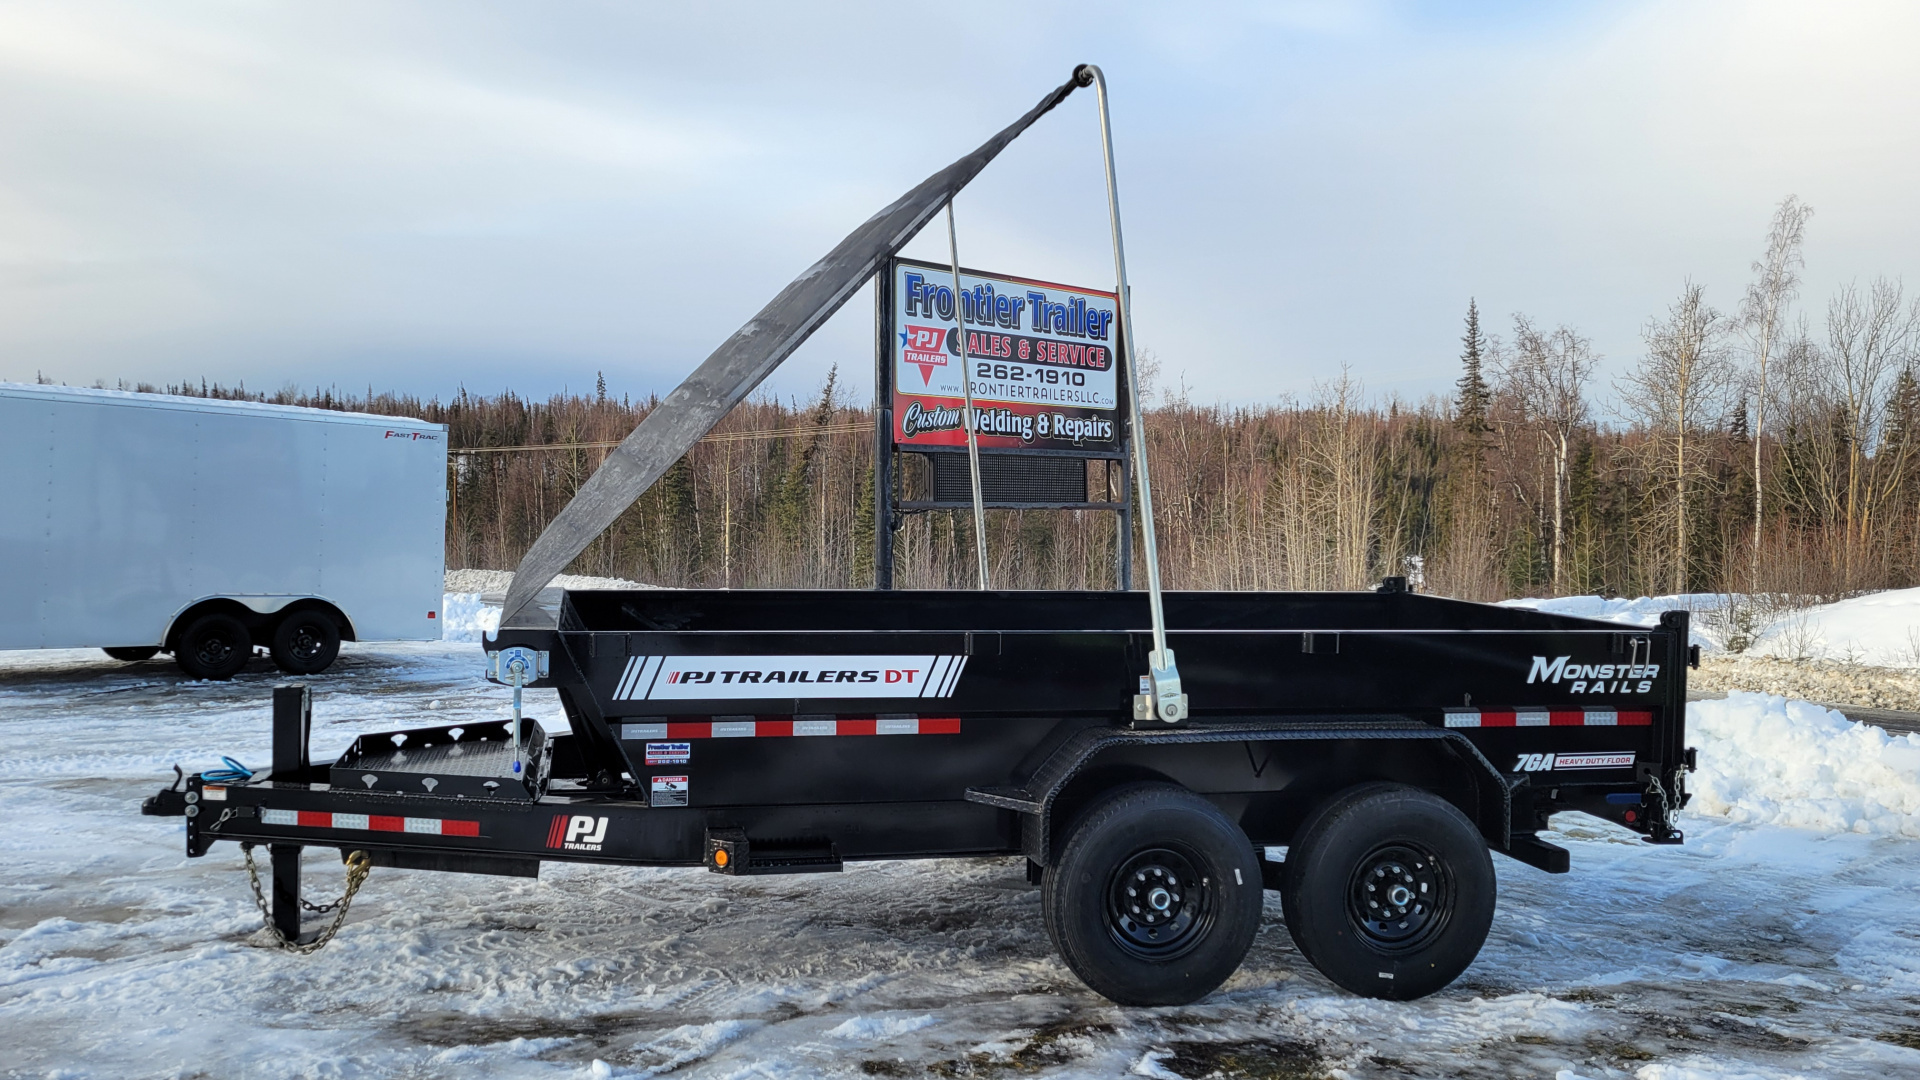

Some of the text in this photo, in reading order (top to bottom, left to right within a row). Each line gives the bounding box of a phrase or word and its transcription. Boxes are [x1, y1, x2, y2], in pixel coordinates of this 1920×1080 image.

[905, 272, 1113, 341] Frontier Trailer
[915, 331, 939, 349] PJ
[906, 352, 946, 364] TRAILERS
[1018, 339, 1030, 359] &
[1037, 341, 1105, 368] SERVICE
[977, 362, 1085, 387] 262-1910
[903, 402, 1112, 442] Custom Welding & Repairs
[884, 669, 920, 684] DT
[1569, 680, 1653, 694] RAILS
[1512, 753, 1555, 772] 7GA
[1559, 758, 1584, 766] HEAVY
[1585, 757, 1606, 765] DUTY
[565, 815, 609, 843] PJ
[564, 842, 602, 851] TRAILERS
